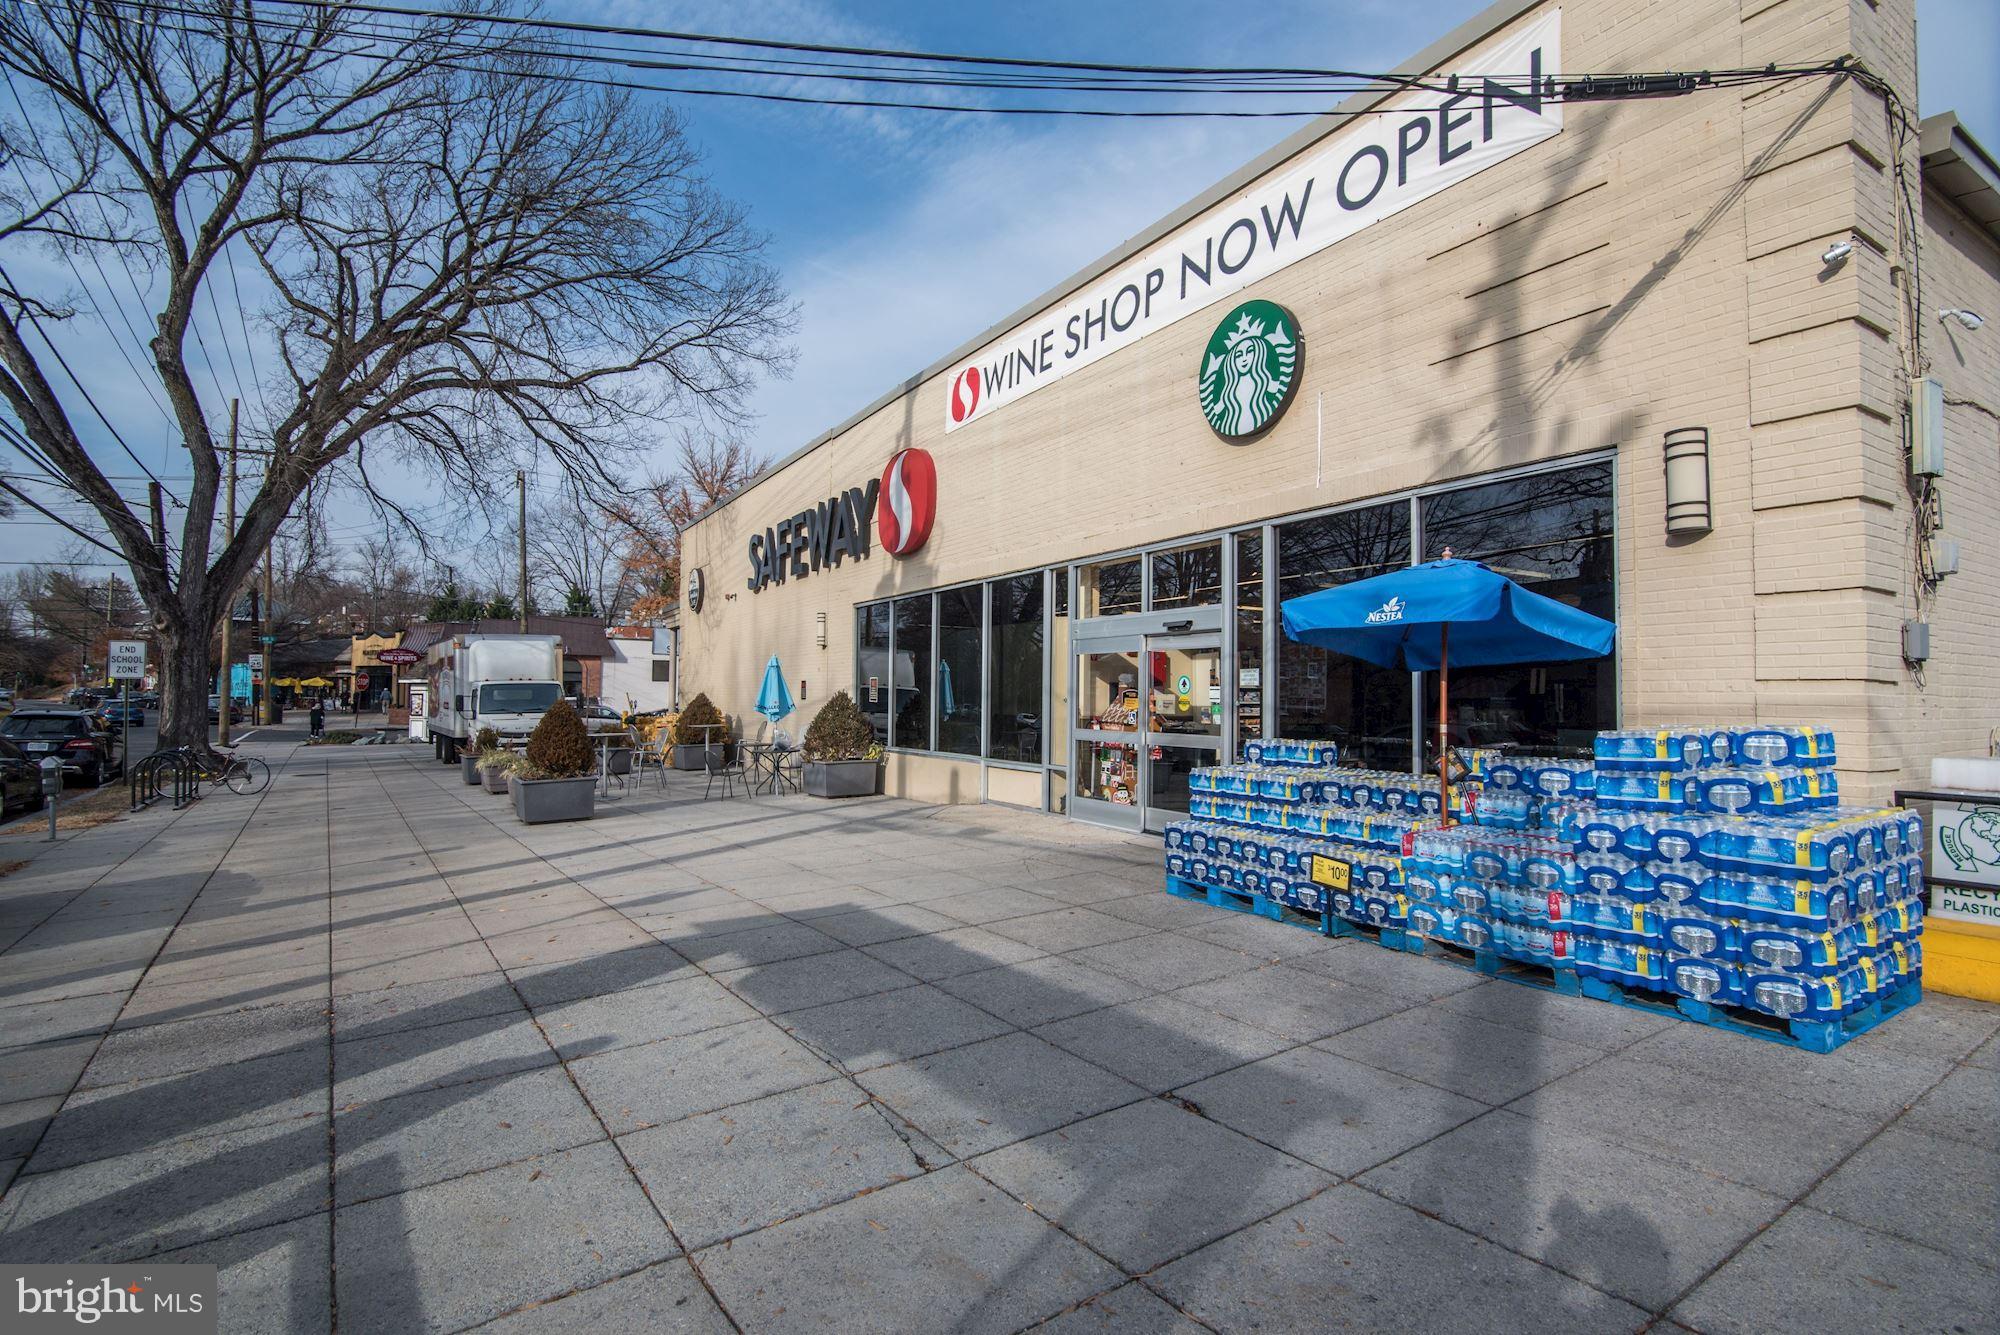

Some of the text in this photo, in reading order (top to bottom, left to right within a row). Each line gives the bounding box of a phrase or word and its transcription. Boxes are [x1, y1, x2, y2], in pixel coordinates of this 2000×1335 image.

[982, 46, 1542, 399] WINE SHOP NOW OPEN
[747, 478, 880, 591] SAFEWAY
[1368, 611, 1403, 622] NESTEA
[119, 645, 136, 653] END
[111, 656, 144, 664] SCHOOL
[116, 665, 138, 674] ZONE
[1944, 833, 1963, 863] REDUCE
